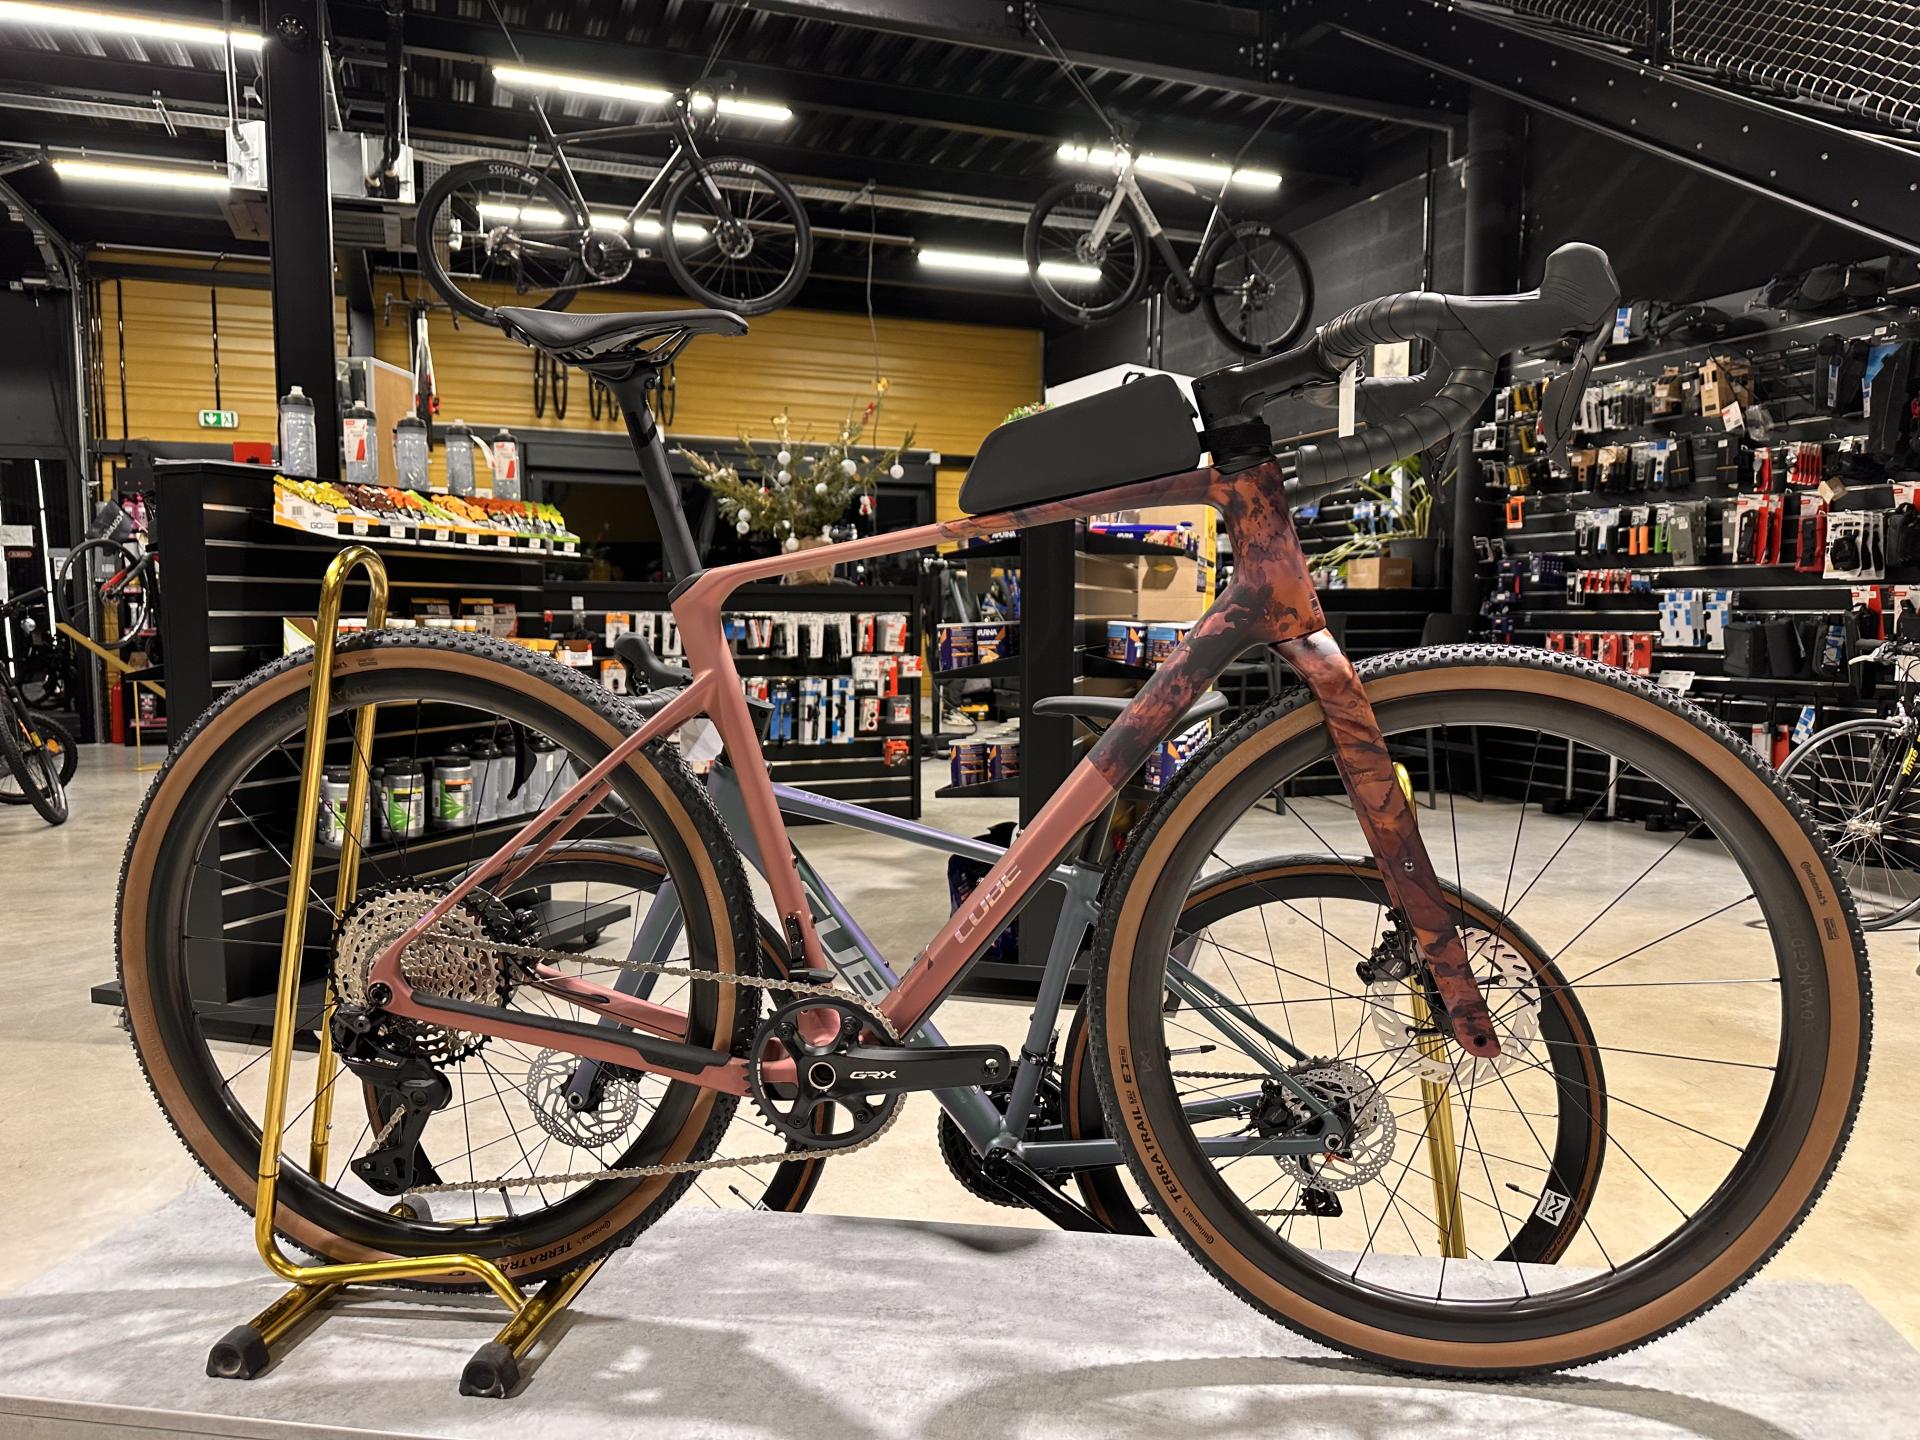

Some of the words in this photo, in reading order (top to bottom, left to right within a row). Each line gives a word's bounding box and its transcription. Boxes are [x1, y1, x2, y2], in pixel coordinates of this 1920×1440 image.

[488, 164, 520, 178] SWISS
[709, 161, 738, 173] SWISS
[739, 163, 756, 175] DT
[521, 173, 539, 186] DT
[955, 861, 1022, 943] CUBE
[850, 1071, 896, 1079] GRX
[1131, 1105, 1152, 1153] TRAIL
[1151, 1153, 1183, 1204] TERRA
[1187, 1211, 1214, 1246] Continental
[529, 1242, 572, 1264] TERRA
[500, 1258, 529, 1272] TRA
